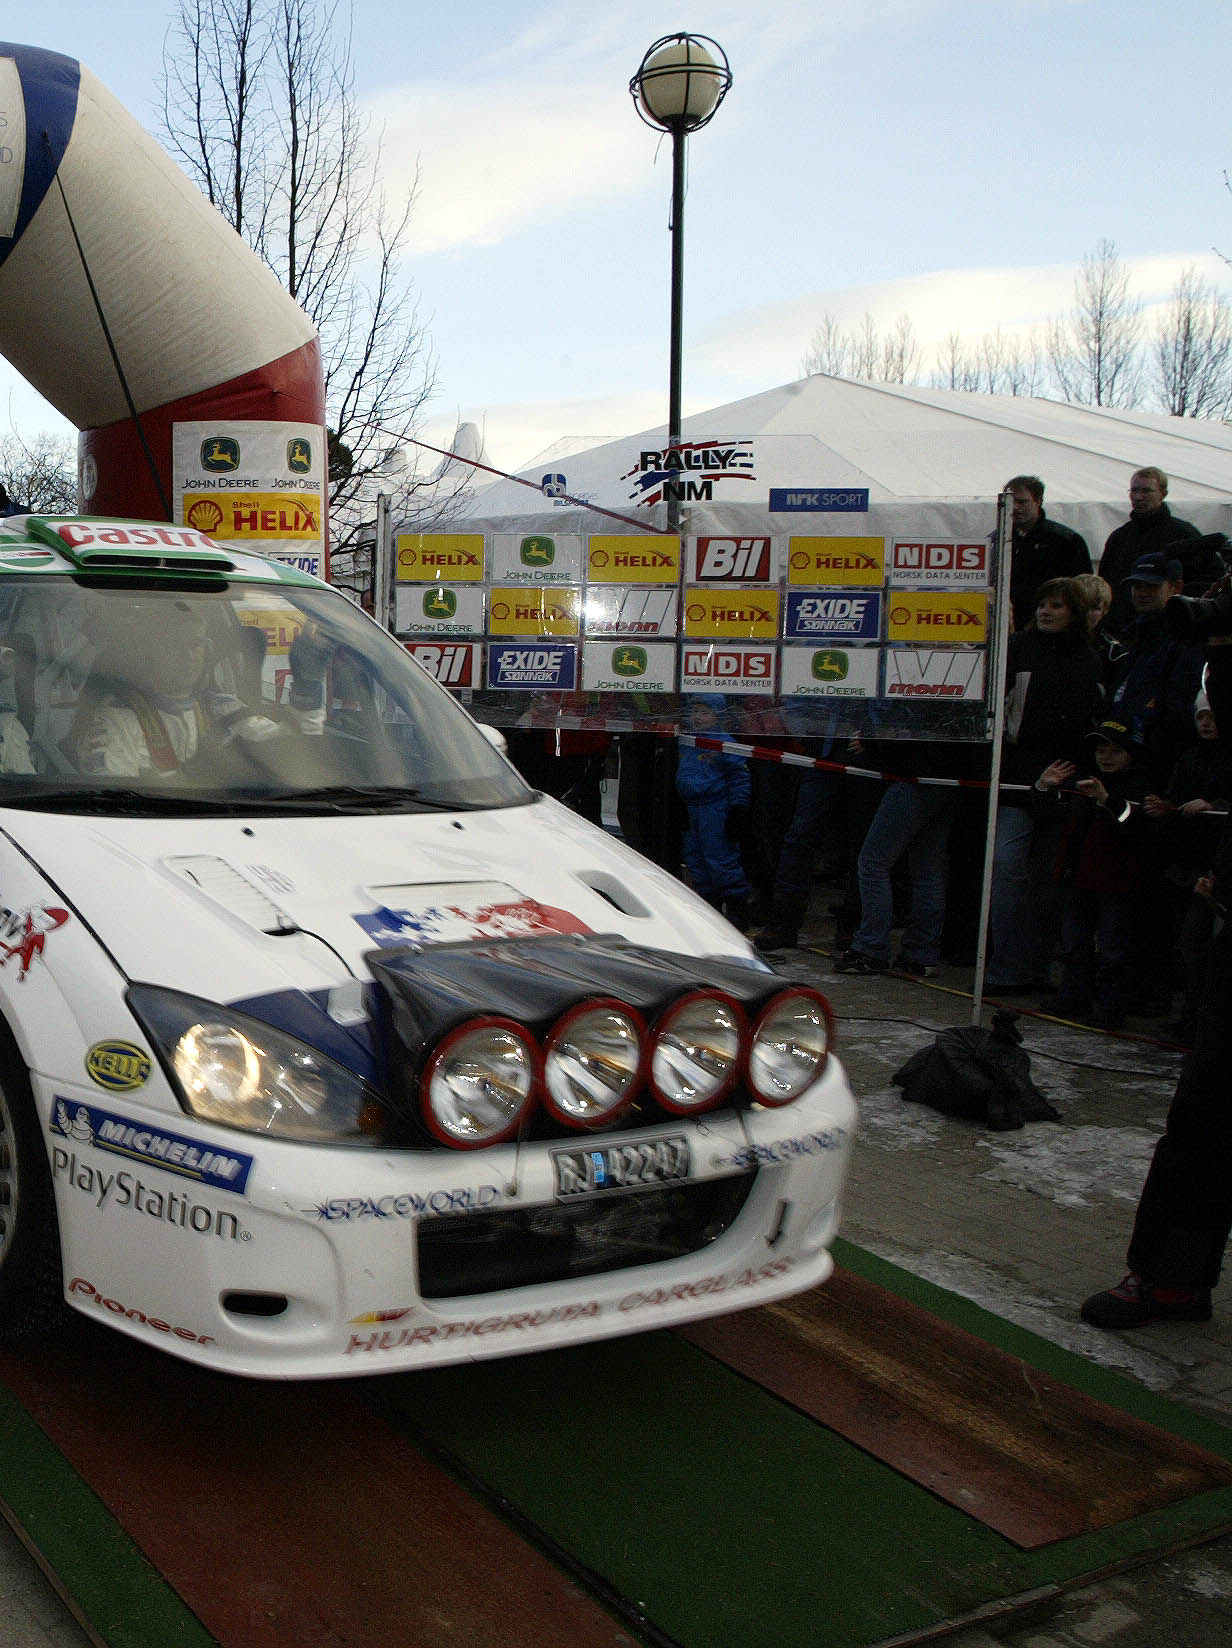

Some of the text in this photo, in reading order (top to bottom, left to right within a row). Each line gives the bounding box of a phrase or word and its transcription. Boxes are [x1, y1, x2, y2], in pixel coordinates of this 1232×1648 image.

[639, 448, 737, 472] RALLY
[181, 477, 259, 489] JOHN DEERE
[271, 477, 298, 489] JOHN
[661, 480, 714, 501] NM
[232, 500, 260, 510] Shell
[823, 493, 864, 506] SPORT
[233, 510, 318, 532] HELIX
[421, 554, 479, 566] HELIX
[614, 555, 676, 568] HELIX
[700, 538, 766, 578] Bil
[816, 556, 881, 570] HELIX
[503, 570, 571, 580] JOHN DEERE
[893, 571, 986, 580] NORSK DATA SENTER
[515, 607, 576, 620] HELIX
[796, 598, 869, 618] EXIDE
[710, 609, 773, 623] HELIX
[917, 612, 982, 626] HELIX
[406, 622, 473, 632] JOHN DEERE
[413, 646, 468, 682] Bil
[498, 651, 564, 670] EXIDE
[593, 680, 665, 690] JOHN DEERE
[683, 678, 771, 687] NORSK DATA SENTER
[792, 684, 824, 695] JOHN
[98, 1119, 243, 1181] MICHELIN
[52, 1146, 238, 1240] PlayStation
[324, 1184, 501, 1222] SPACEWORLD
[69, 1276, 216, 1345] Pioneer
